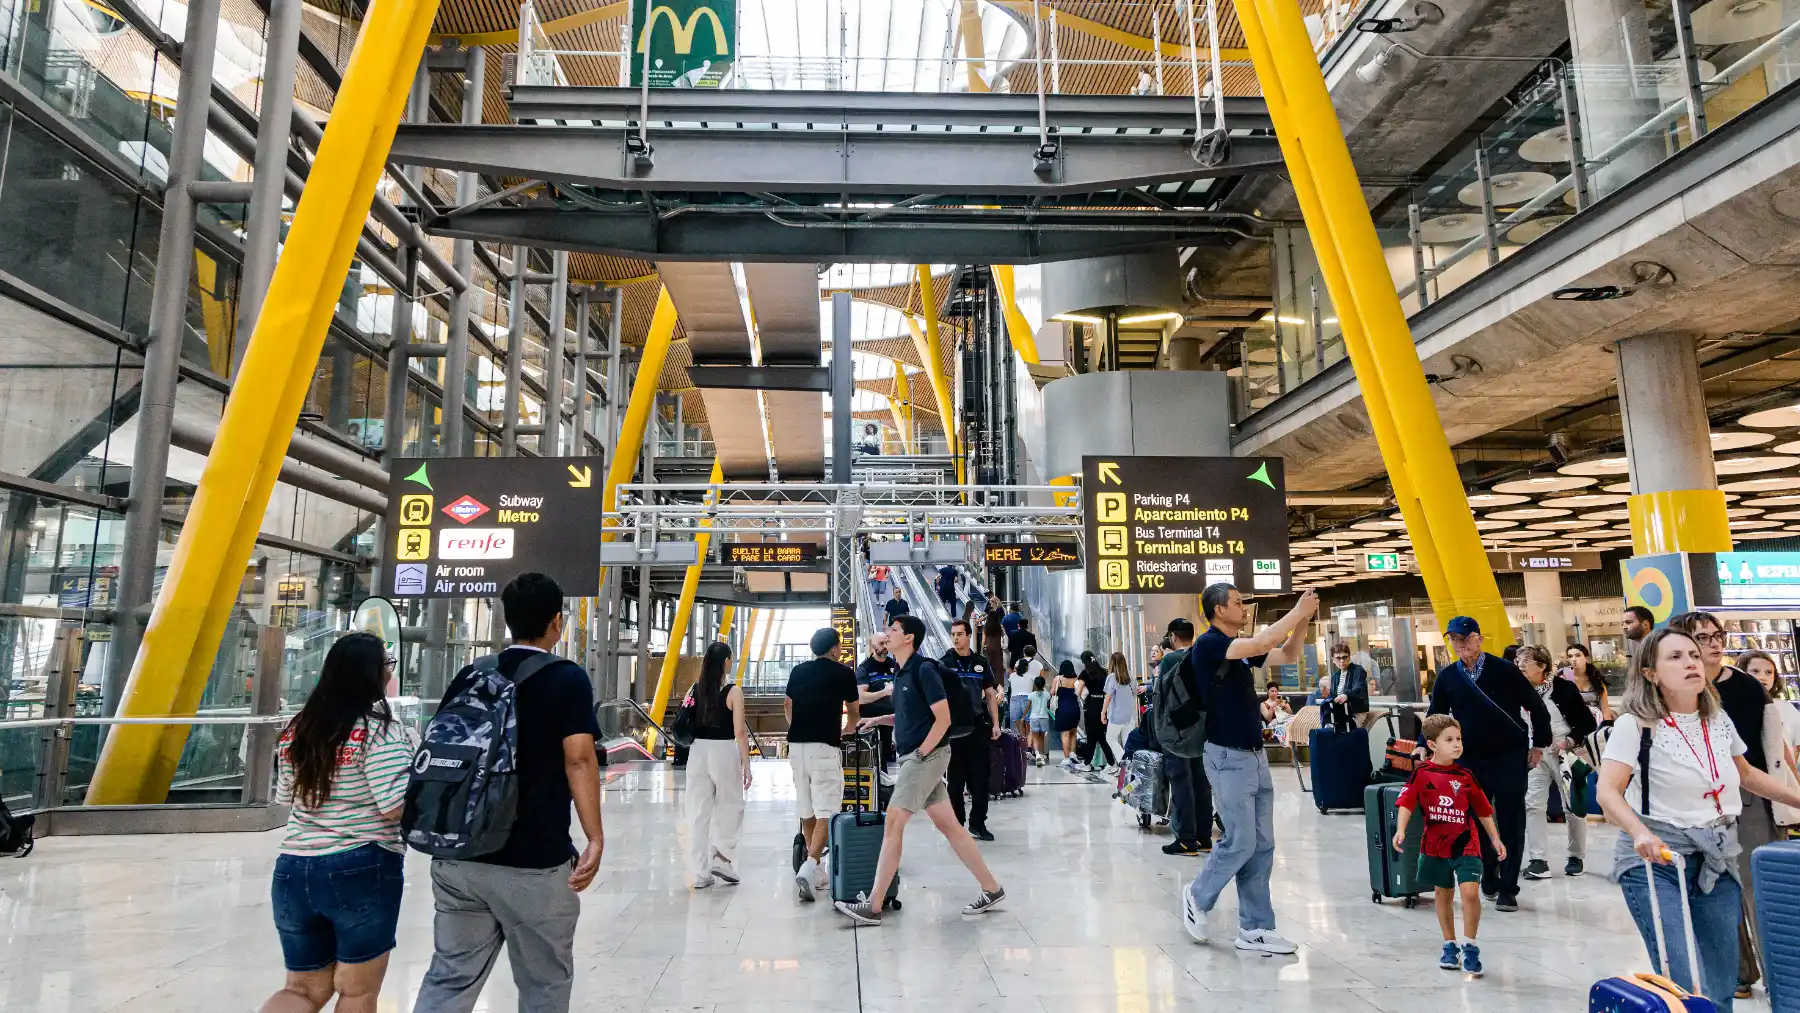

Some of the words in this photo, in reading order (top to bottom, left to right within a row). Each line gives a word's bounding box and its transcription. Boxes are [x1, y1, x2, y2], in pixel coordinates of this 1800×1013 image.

[499, 494, 544, 509] Subway
[1104, 497, 1120, 518] P
[1134, 494, 1173, 508] Parking
[1175, 494, 1190, 506] P4
[498, 510, 540, 523] Metro
[1134, 508, 1228, 523] Aparcamiento
[1231, 508, 1249, 521] P4
[1135, 527, 1155, 539] Bus
[1158, 526, 1203, 539] Terminal
[1205, 527, 1220, 539] T4
[447, 531, 506, 554] renfe
[1136, 541, 1195, 555] Terminal
[1199, 541, 1224, 555] Bus
[1227, 541, 1245, 555] T4
[985, 548, 1022, 561] HERE
[435, 565, 452, 577] Air
[454, 566, 484, 577] room
[1136, 560, 1198, 575] Ridesharing
[1207, 561, 1231, 572] Uber
[1256, 560, 1277, 572] Bolt
[434, 580, 454, 593] Air
[459, 582, 497, 593] room
[1136, 574, 1165, 588] VTC
[1428, 805, 1465, 817] MIRANDA
